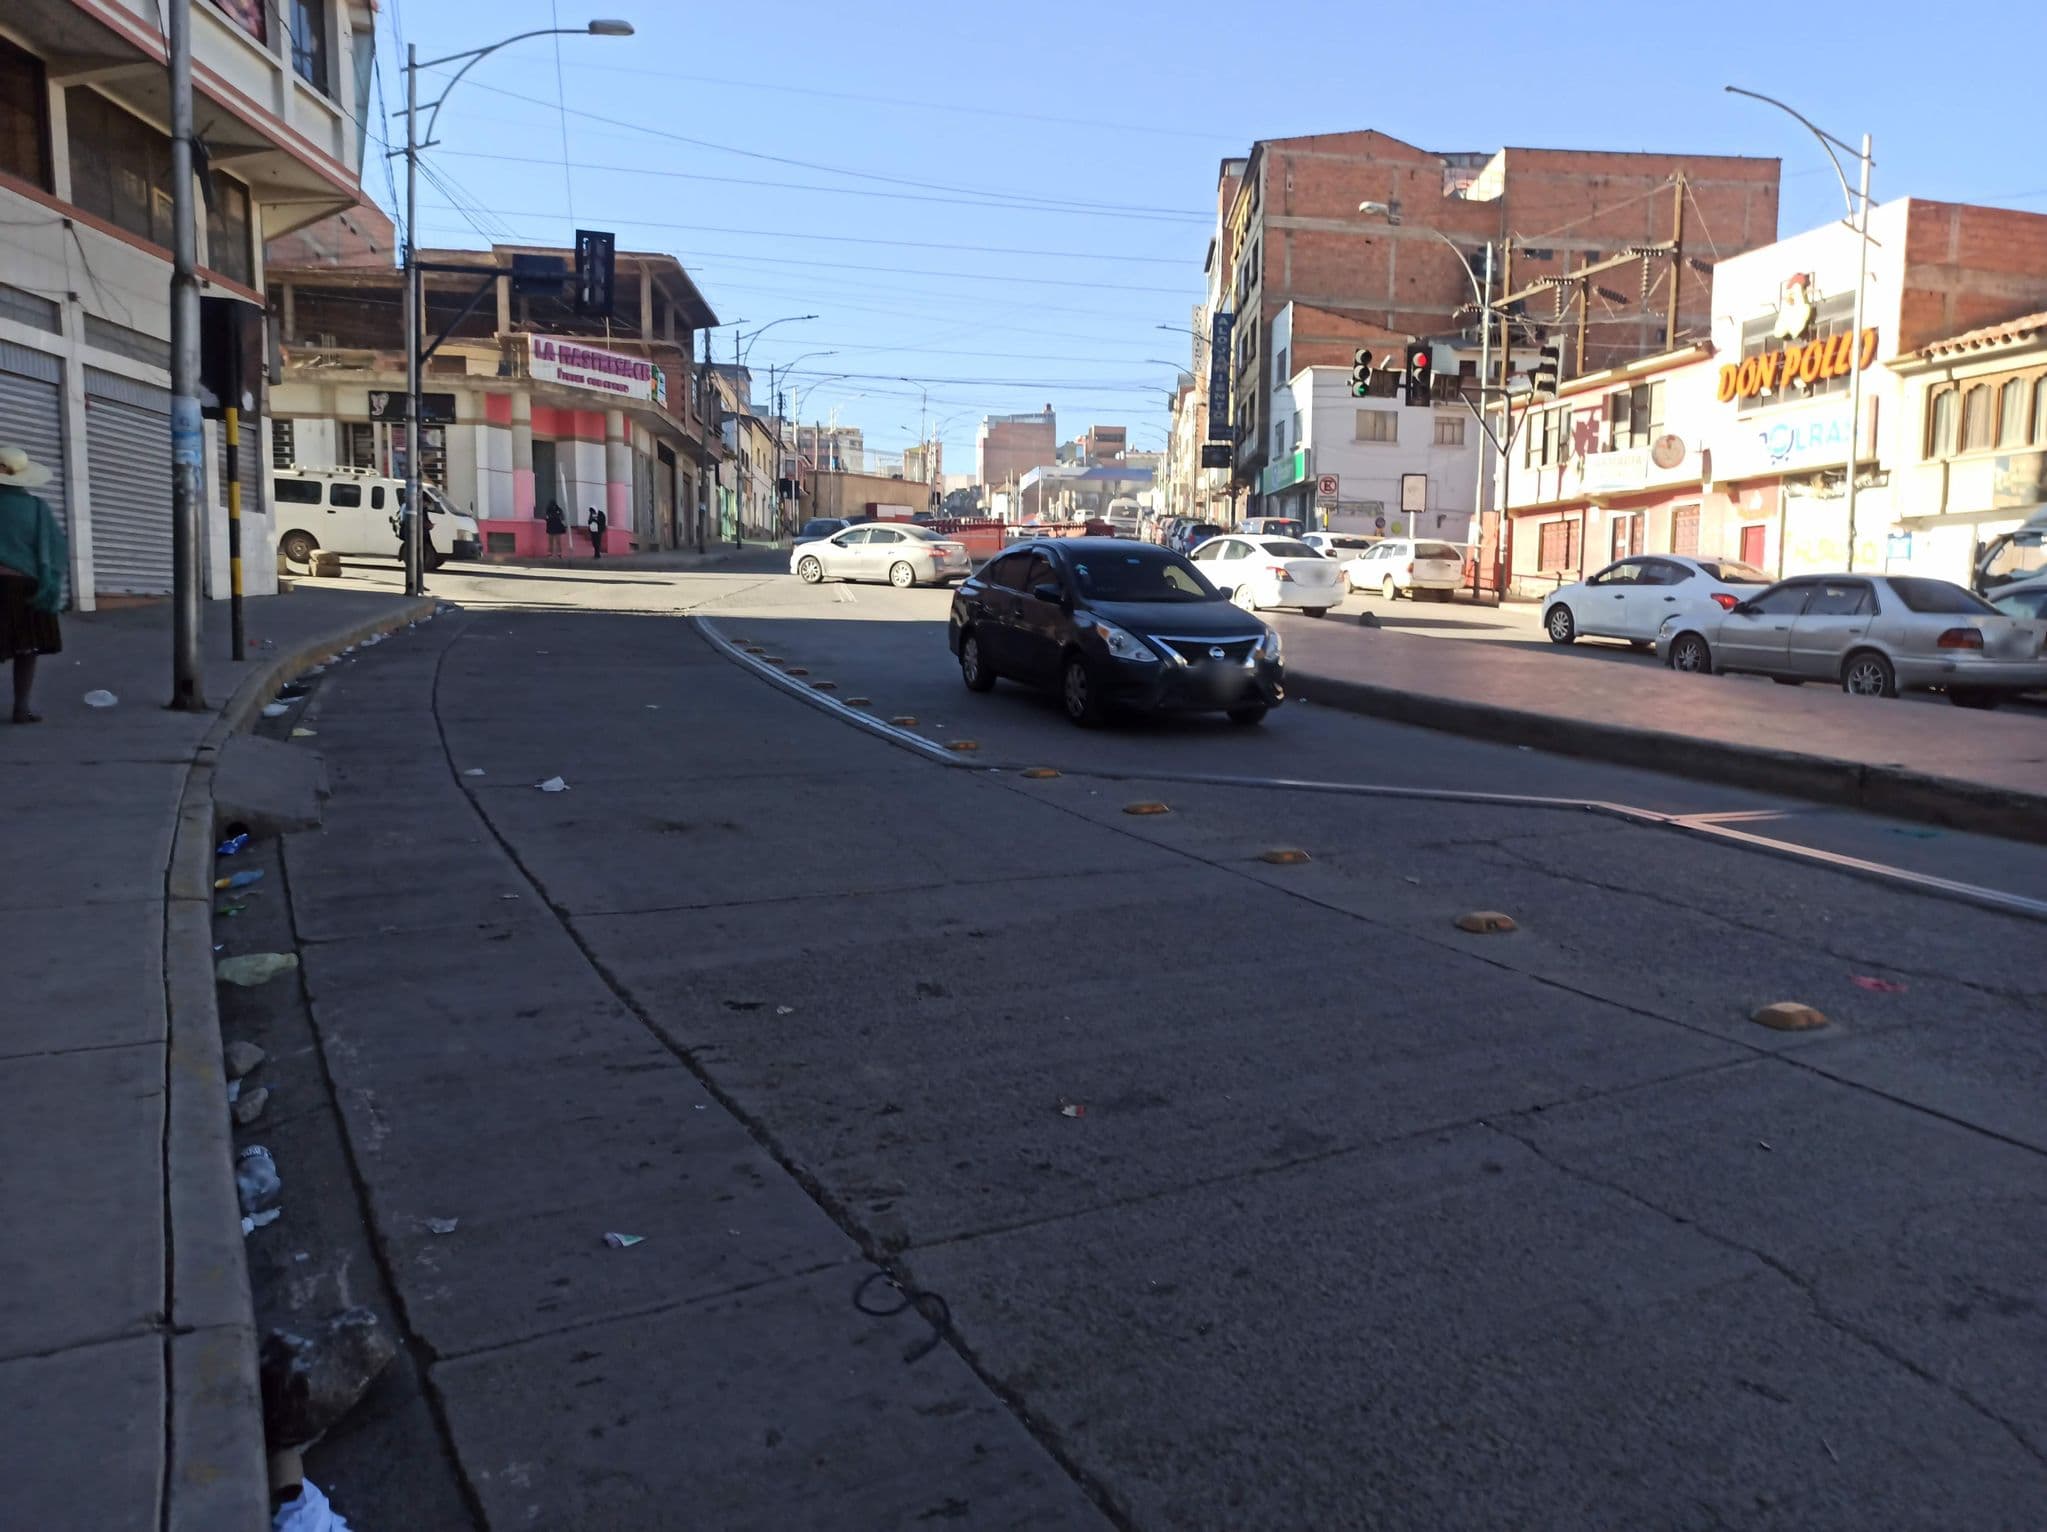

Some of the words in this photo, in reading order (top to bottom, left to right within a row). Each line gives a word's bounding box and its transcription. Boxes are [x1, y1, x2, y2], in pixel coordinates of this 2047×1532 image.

[534, 339, 556, 361] LA
[1213, 317, 1229, 418] ALOJAMIENTO
[1718, 351, 1778, 402] DON
[1782, 328, 1877, 387] POLLO
